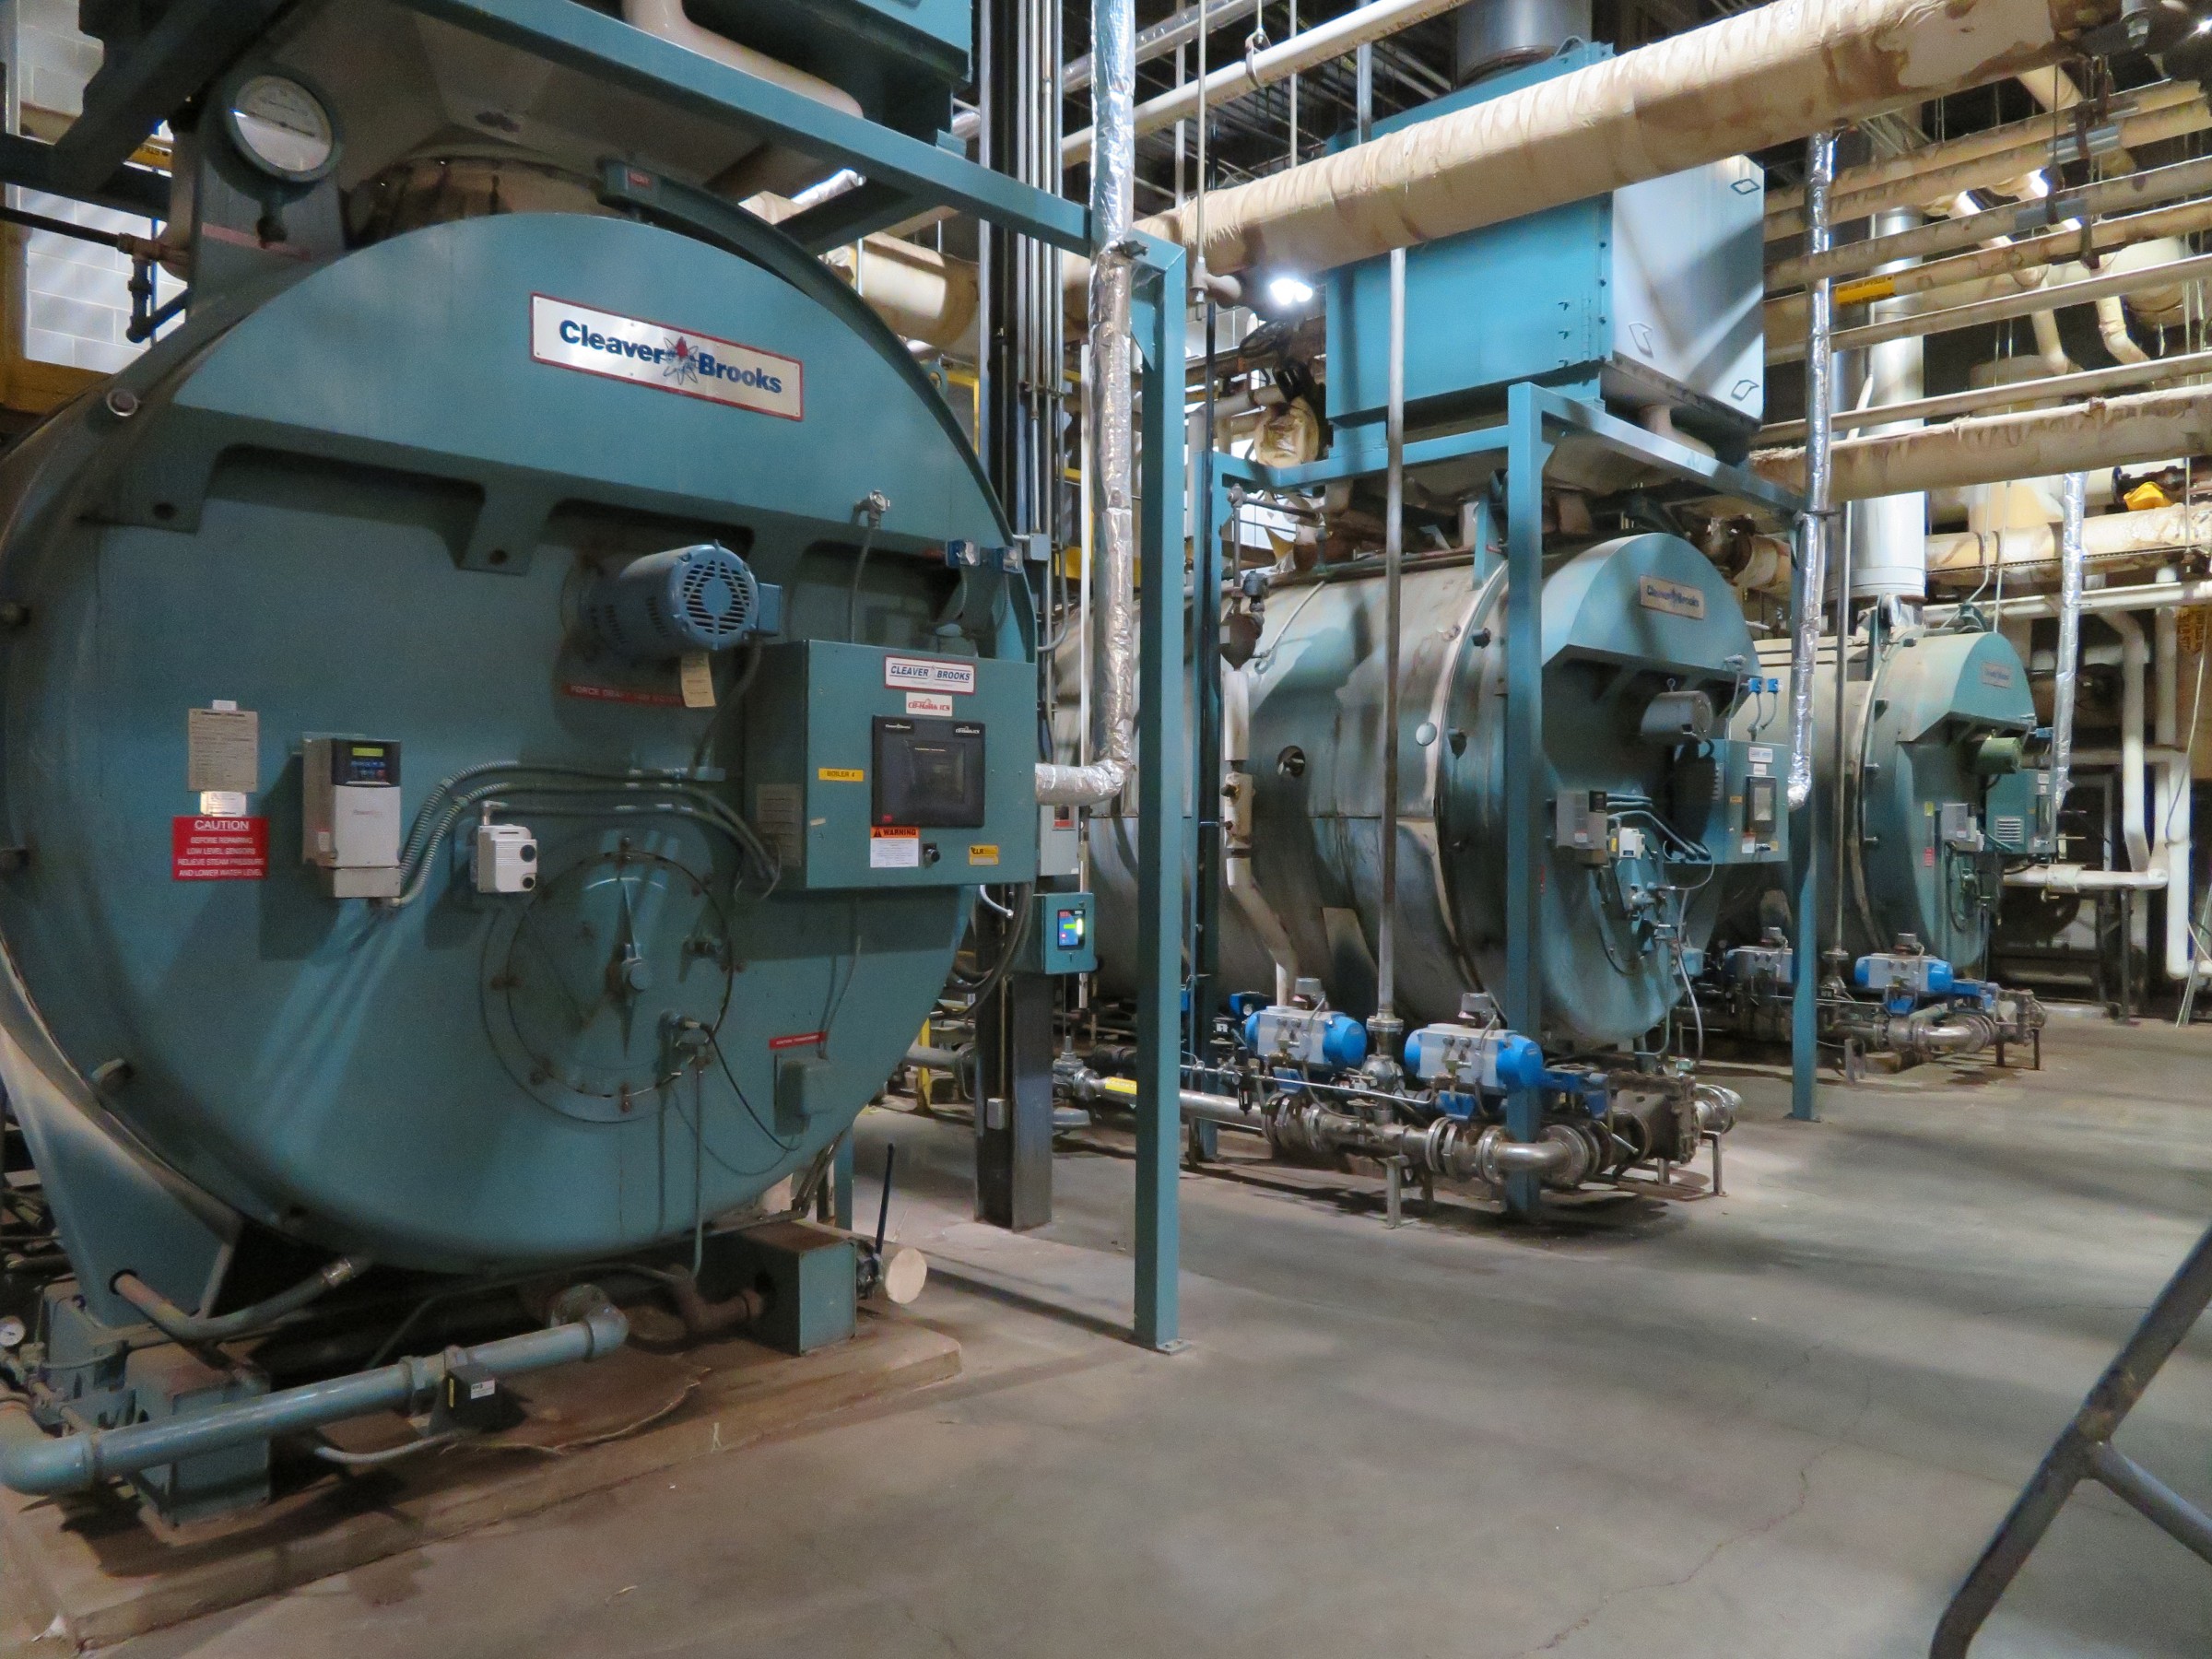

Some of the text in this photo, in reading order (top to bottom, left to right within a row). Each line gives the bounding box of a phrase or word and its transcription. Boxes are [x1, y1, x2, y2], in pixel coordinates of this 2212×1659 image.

[559, 319, 782, 394] Cleaver Brooks
[890, 665, 971, 681] CLEAVER BROOKS
[827, 770, 850, 778] BOILER
[194, 819, 250, 830] CAUTION
